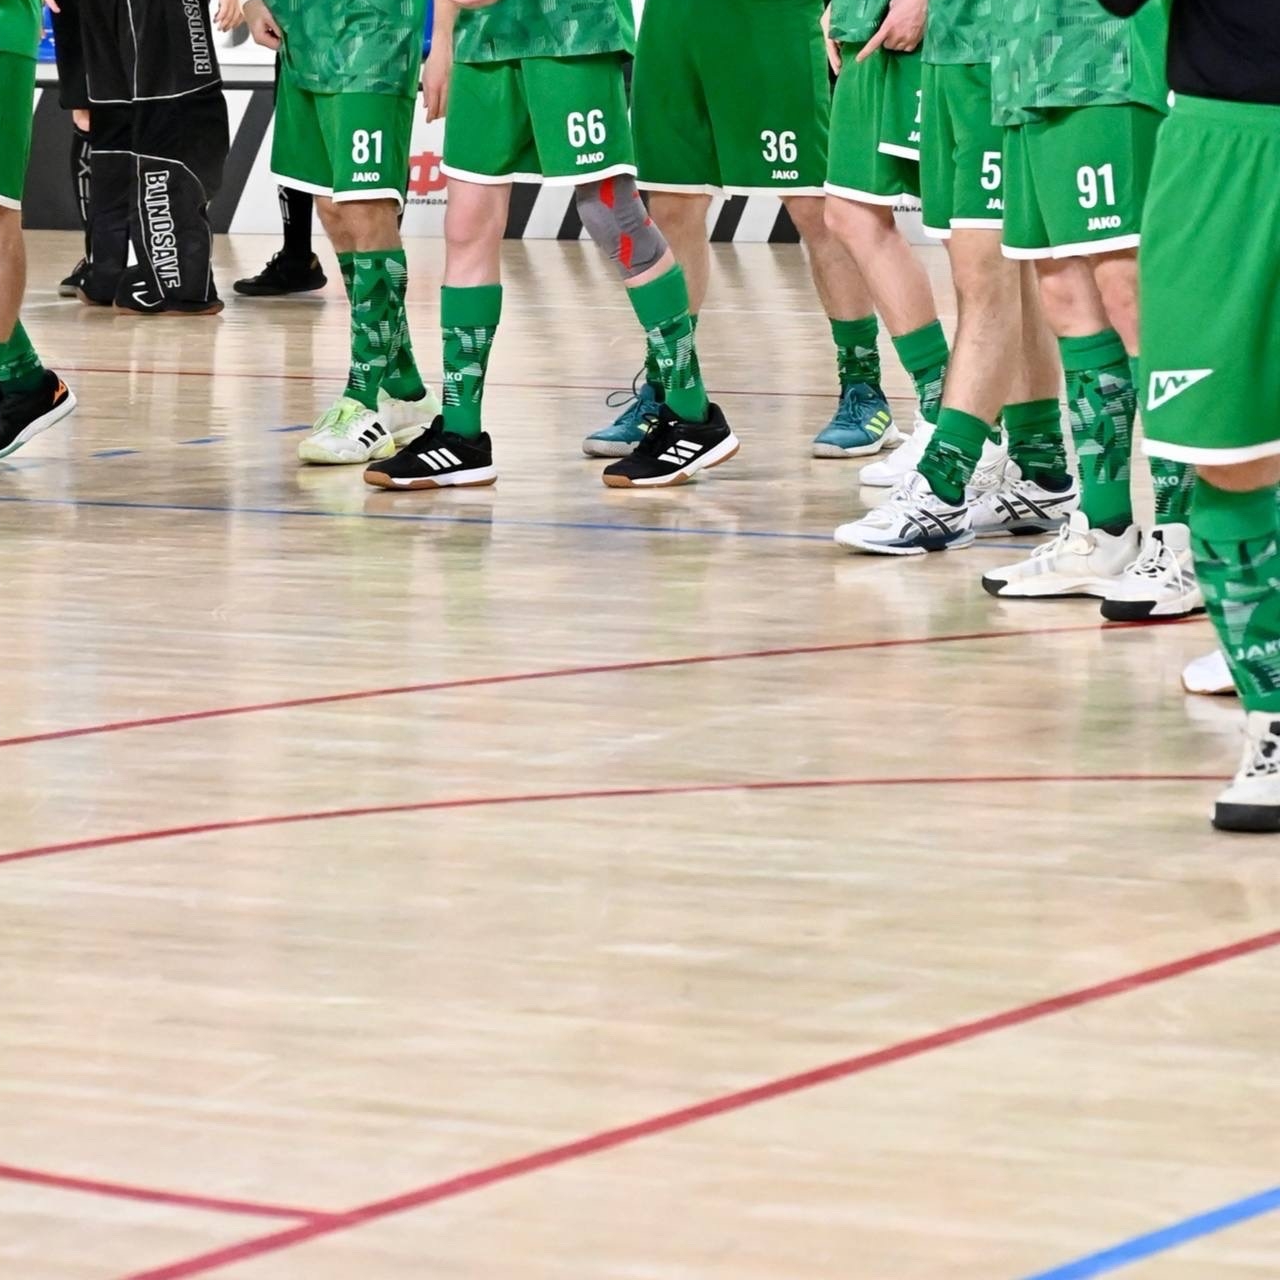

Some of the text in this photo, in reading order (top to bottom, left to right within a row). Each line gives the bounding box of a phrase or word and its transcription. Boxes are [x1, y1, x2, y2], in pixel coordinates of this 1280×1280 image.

[567, 109, 606, 148] 66
[352, 129, 383, 164] 81
[576, 151, 605, 165] JAKO
[760, 130, 797, 163] 36
[352, 172, 380, 182] JAKO
[771, 170, 799, 180] JAKO
[1077, 163, 1115, 209] 91
[1087, 215, 1121, 231] JAKO
